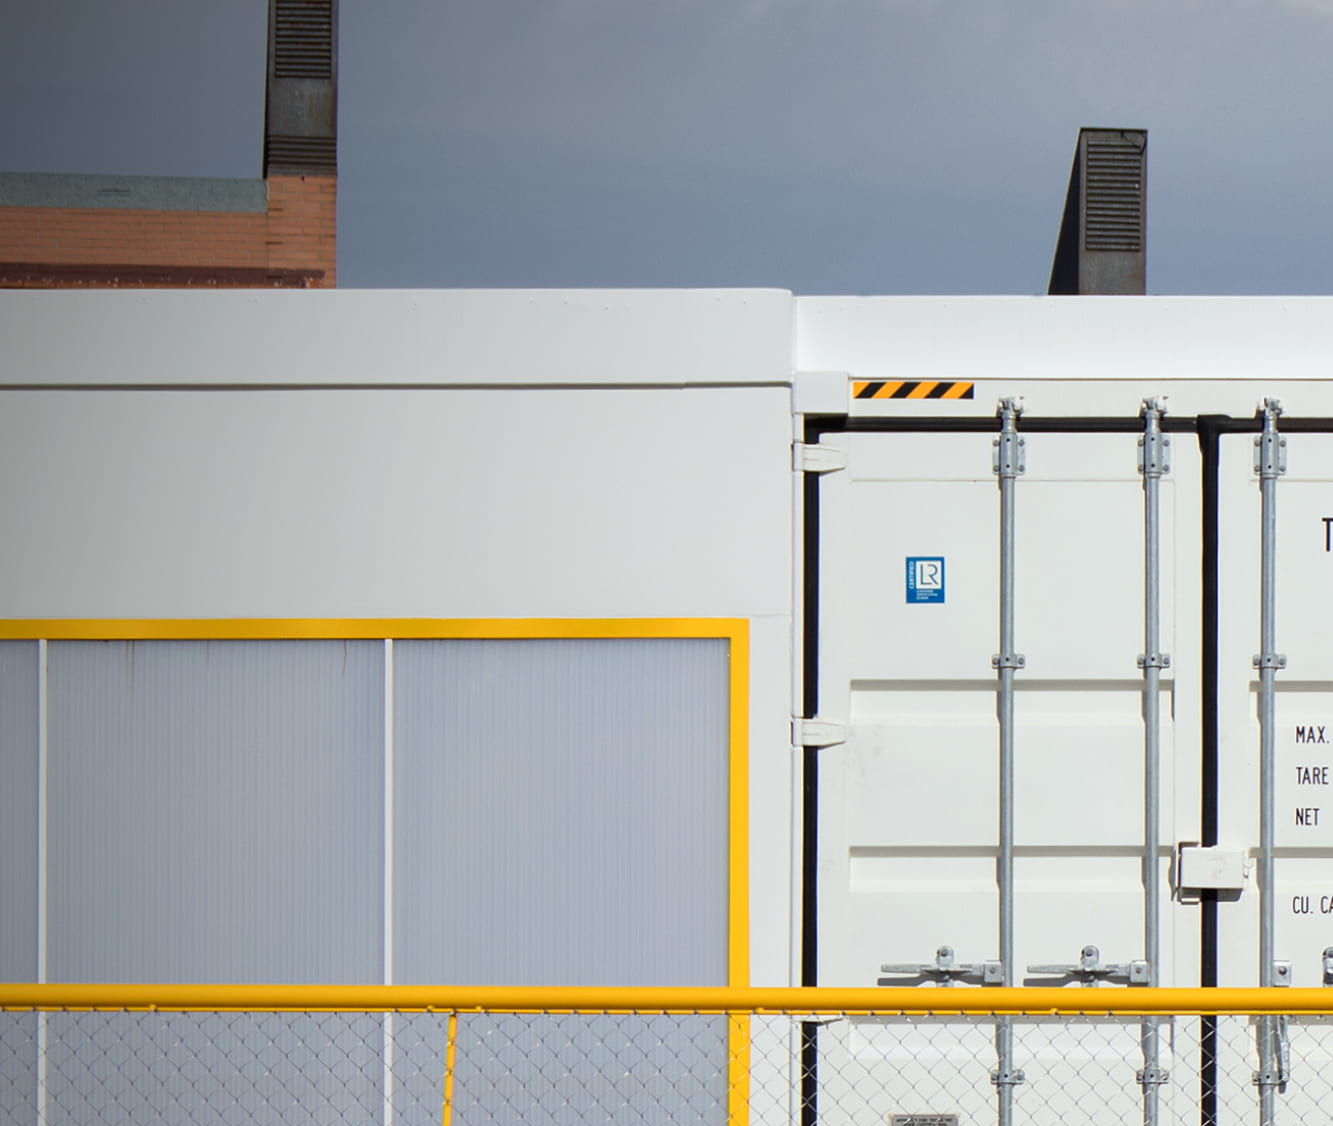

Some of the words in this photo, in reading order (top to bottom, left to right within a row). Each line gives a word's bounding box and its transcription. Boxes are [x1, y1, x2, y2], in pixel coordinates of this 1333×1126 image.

[920, 564, 938, 585] LR
[1296, 726, 1329, 743] MAX.
[1296, 767, 1328, 784] TARE
[1296, 808, 1319, 825] NET
[1293, 896, 1313, 914] CU.
